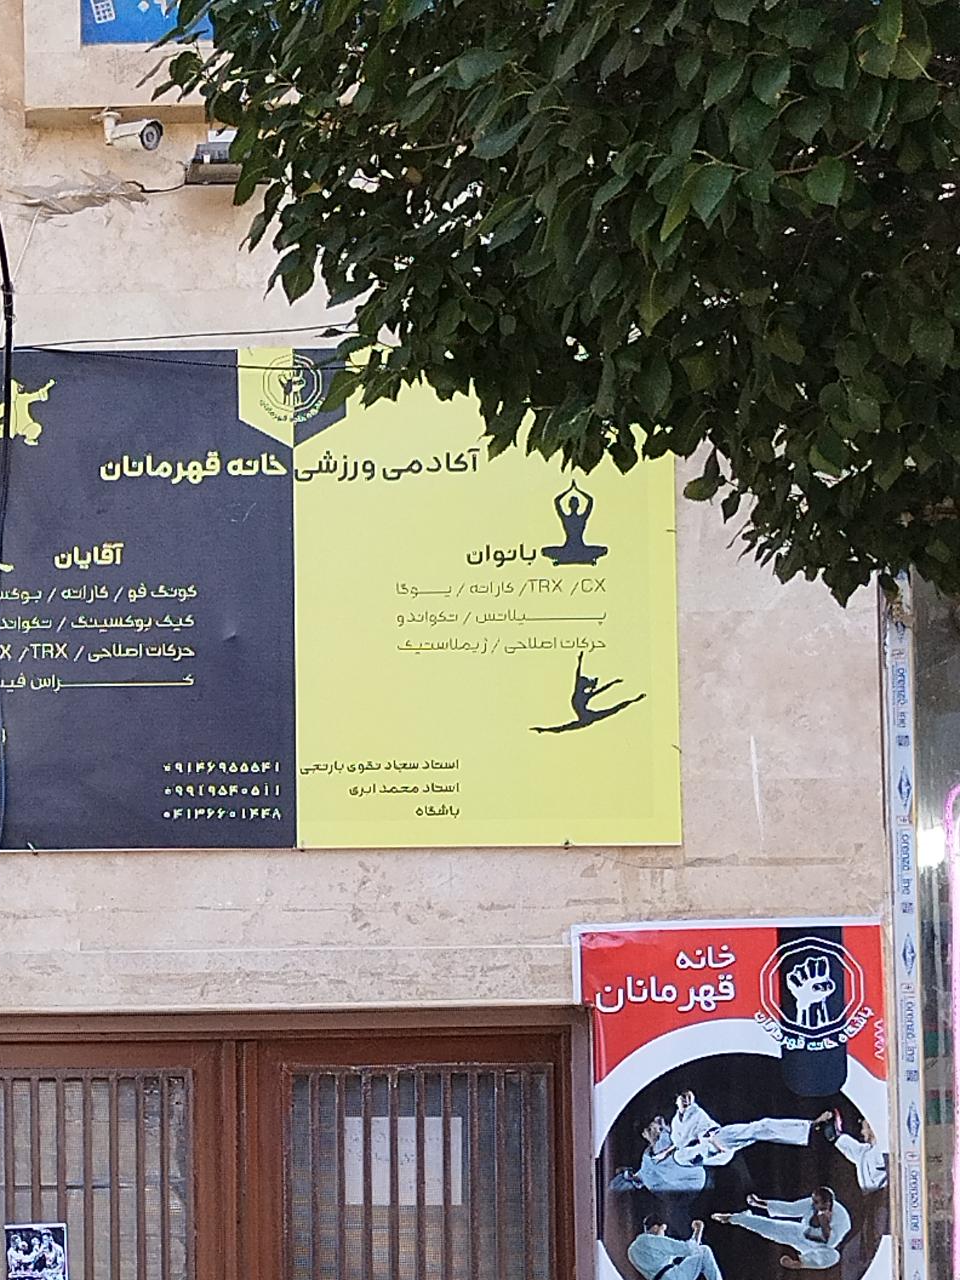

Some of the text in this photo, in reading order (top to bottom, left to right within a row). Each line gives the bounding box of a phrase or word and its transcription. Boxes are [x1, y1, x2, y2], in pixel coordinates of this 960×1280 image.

[100, 448, 480, 484] آکادمی ورزشی خانه قهرمانان
[54, 542, 124, 569] آقایان
[466, 544, 537, 567] بانوان
[61, 585, 108, 603] کاراته
[128, 583, 147, 602] فو
[151, 584, 197, 601] کونگ
[396, 581, 452, 598] یوگا
[470, 581, 514, 598] کاراته
[71, 616, 152, 632] بوکسینگ
[156, 614, 194, 631] کیک
[396, 609, 606, 627] پیلاتس تکواندو
[88, 644, 142, 662] اصلاحی
[146, 645, 195, 661] حرکات
[504, 637, 556, 653] اصلاحی
[560, 637, 606, 653] حرکات
[384, 760, 419, 772] سجاد
[422, 759, 460, 770] استاد
[379, 783, 419, 794] محمد
[422, 783, 460, 793] استاد
[415, 805, 460, 818] باشگاه
[675, 944, 735, 969] خانه
[595, 973, 735, 1013] قهرمانان
